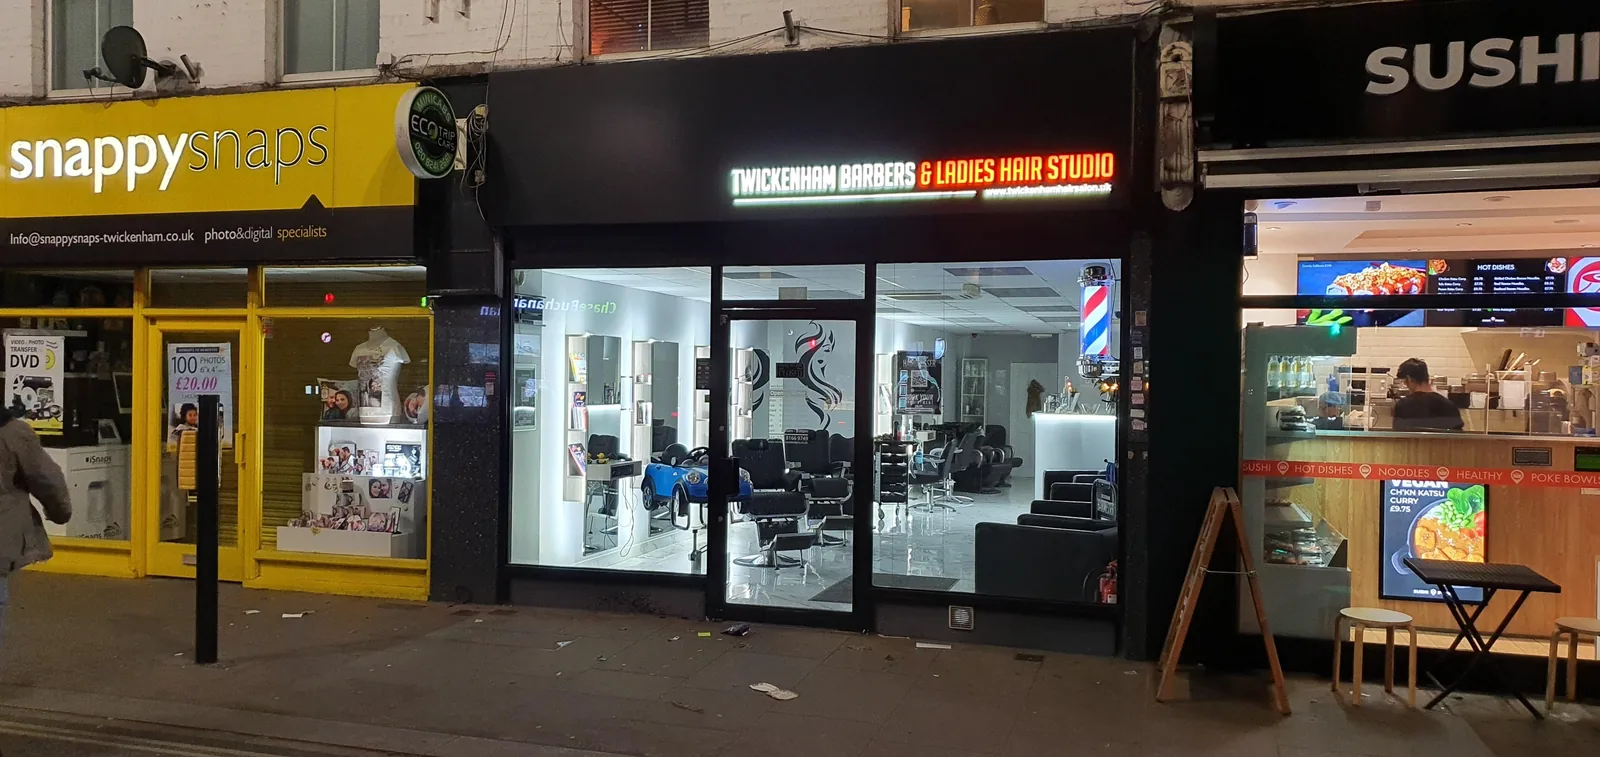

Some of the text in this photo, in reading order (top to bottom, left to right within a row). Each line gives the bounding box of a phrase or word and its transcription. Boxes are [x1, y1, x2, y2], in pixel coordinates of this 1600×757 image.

[1364, 31, 1600, 95] SUSHI
[416, 94, 452, 122] MINICABS
[411, 114, 439, 140] ECO
[438, 126, 456, 140] TRIP
[437, 137, 455, 151] CARS
[9, 123, 329, 193] snappysnaps
[730, 152, 1114, 195] TWICKENHAM BARBERS & LADIES HAIR STUDIO
[10, 225, 327, 247] Info@snappysnaps-twickenham.co.uk photo&digital specialists
[10, 354, 40, 368] DVD
[171, 356, 226, 374] 100 PHOTOS
[175, 376, 218, 391] £20.00
[1242, 462, 1271, 472] SUSHI
[1294, 464, 1315, 473] HOT
[1318, 465, 1353, 475] DISHES
[1378, 467, 1430, 478] NOODLES
[1456, 470, 1503, 481] HEALTHY
[1531, 473, 1561, 483] POKE
[1418, 489, 1445, 497] KATSU
[1389, 505, 1411, 513] £9.75
